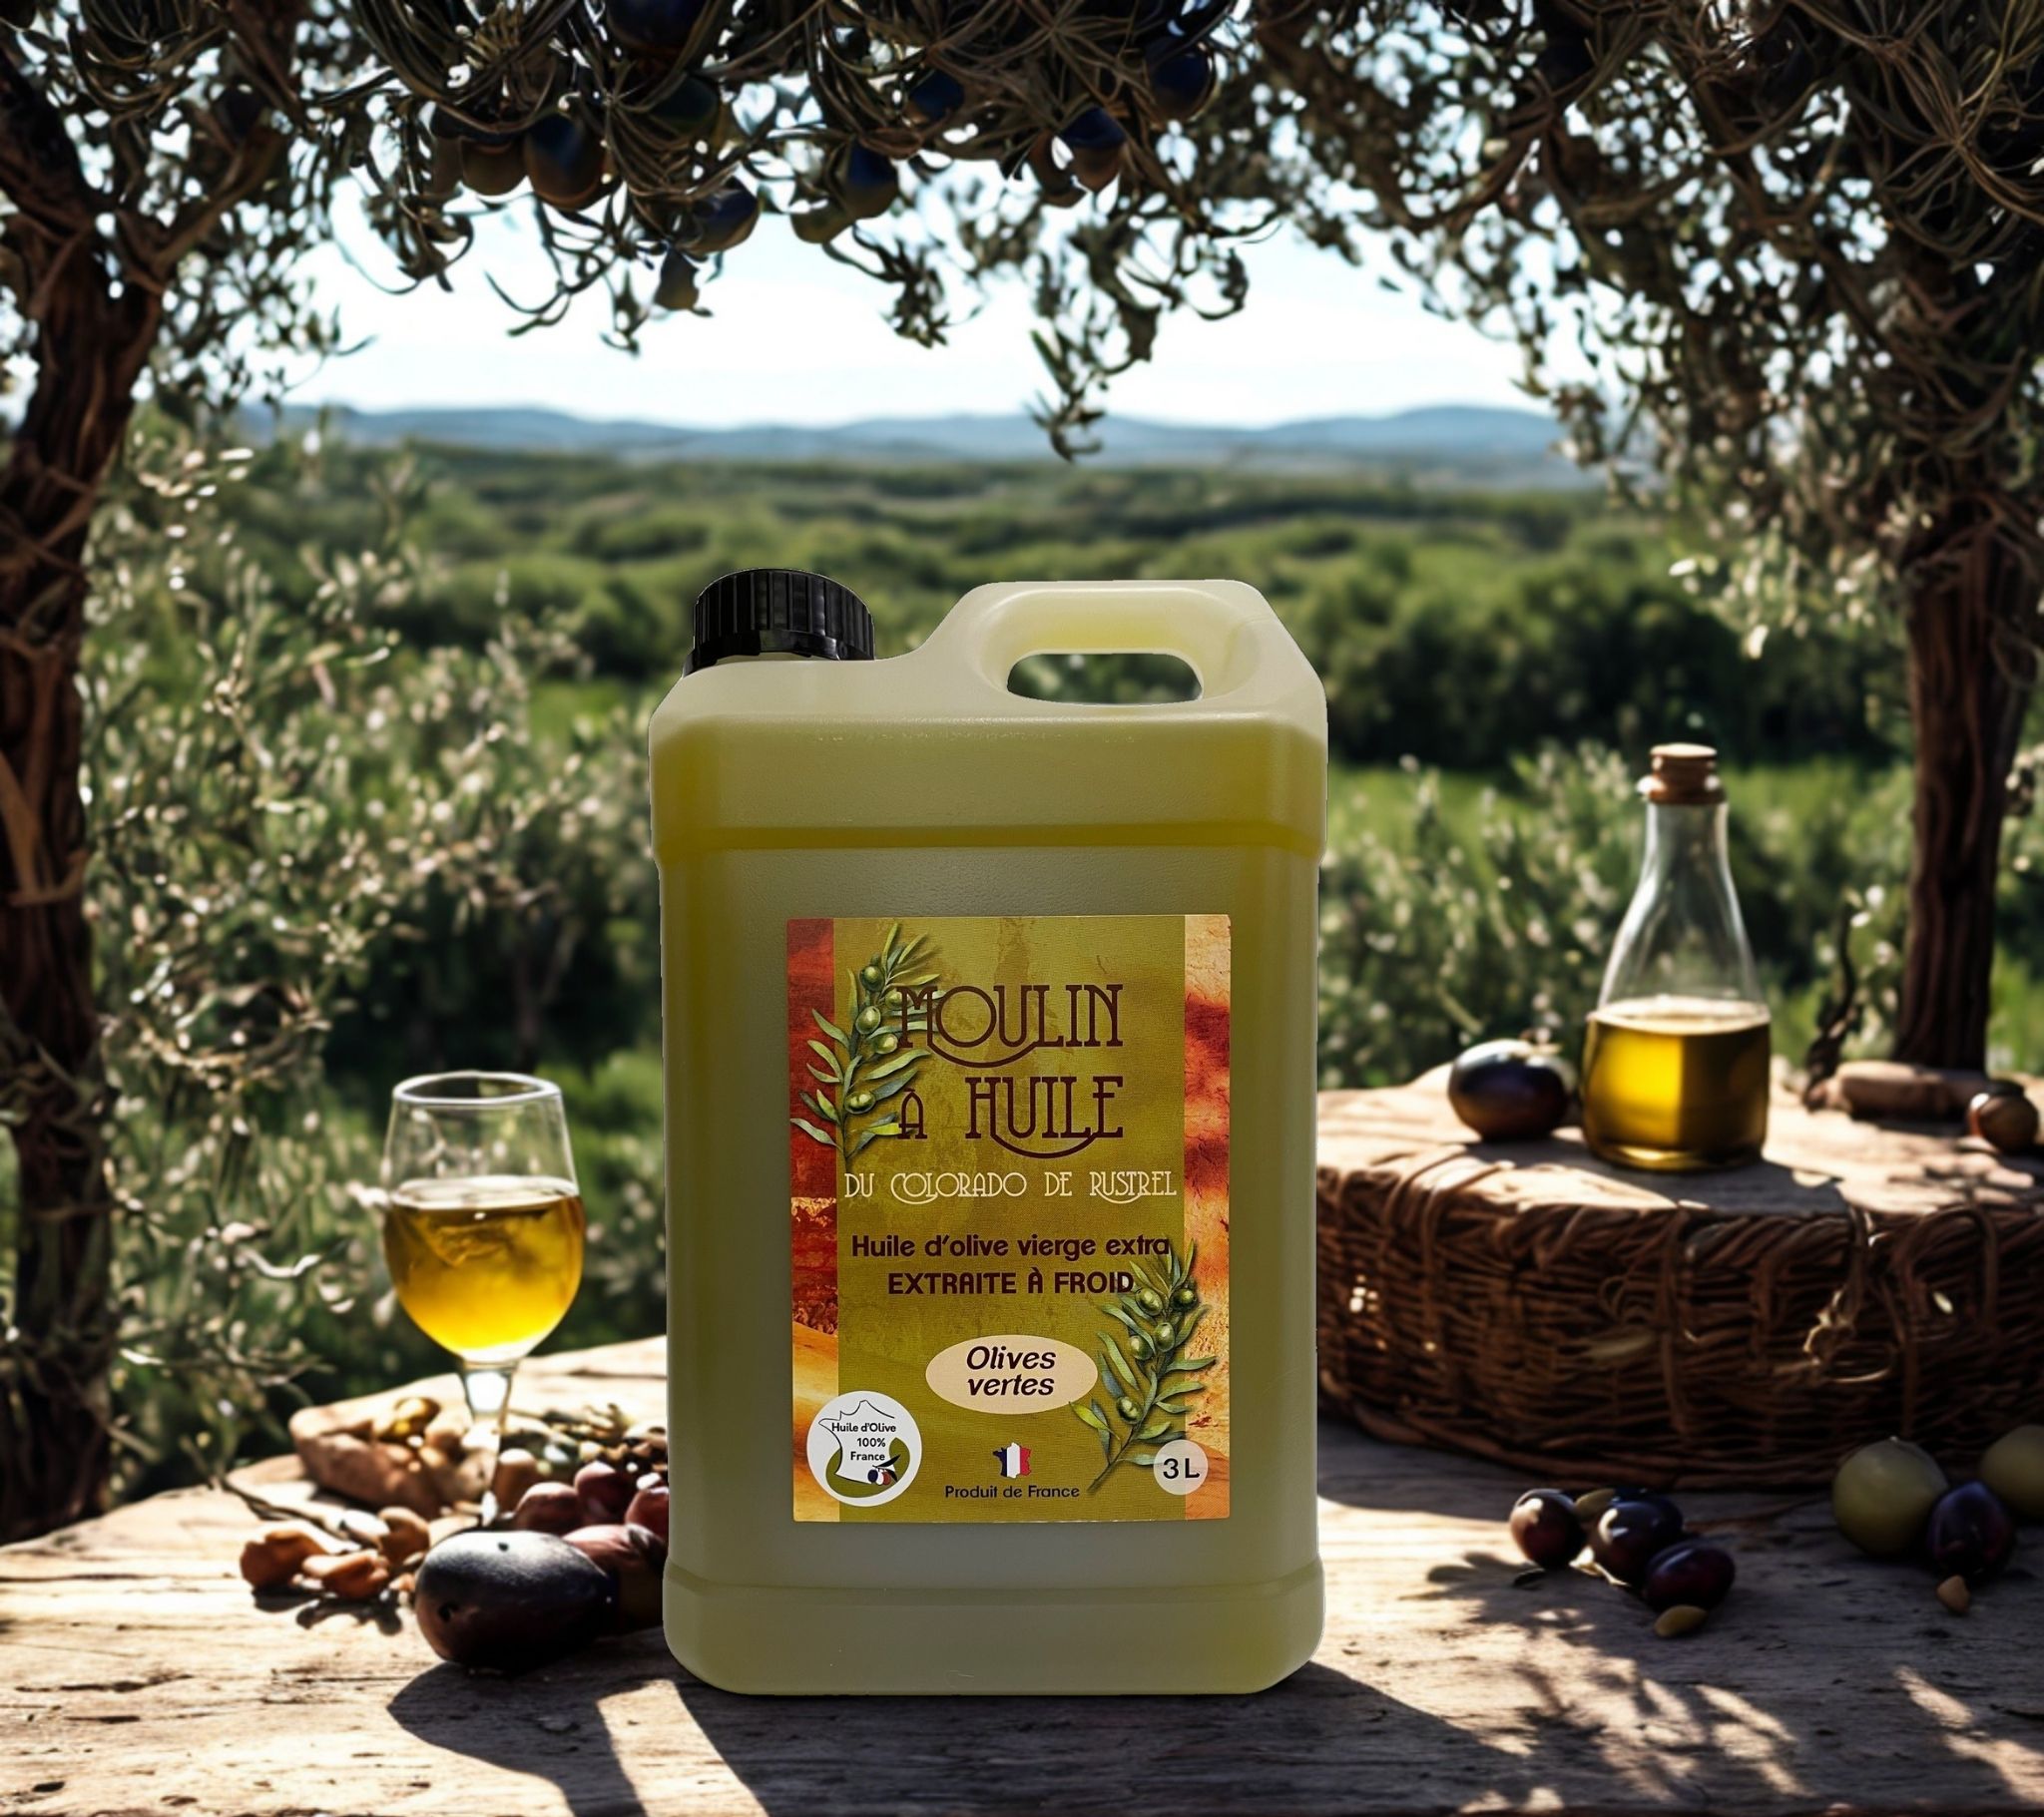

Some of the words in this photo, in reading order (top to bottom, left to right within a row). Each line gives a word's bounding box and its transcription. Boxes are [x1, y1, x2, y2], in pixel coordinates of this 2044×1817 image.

[896, 984, 1124, 1068] MOULIN
[965, 1076, 1124, 1158] HUILE
[844, 1172, 873, 1197] DU
[890, 1171, 1027, 1204] COLORADO
[1045, 1171, 1072, 1196] DE
[1089, 1170, 1177, 1203] RUSTREL
[851, 1234, 915, 1257] Huile
[1017, 1234, 1096, 1261] vierge
[1106, 1235, 1170, 1255] extra
[888, 1272, 1016, 1294] EXTRAITE
[1054, 1271, 1135, 1293] FROID
[965, 1345, 1056, 1370] Olives
[967, 1375, 1055, 1396] vertes
[831, 1421, 858, 1433] Huile
[856, 1437, 886, 1448] 100%
[849, 1451, 885, 1462] France
[944, 1485, 998, 1498] Produit
[1002, 1485, 1023, 1498] de
[1028, 1485, 1080, 1498] France
